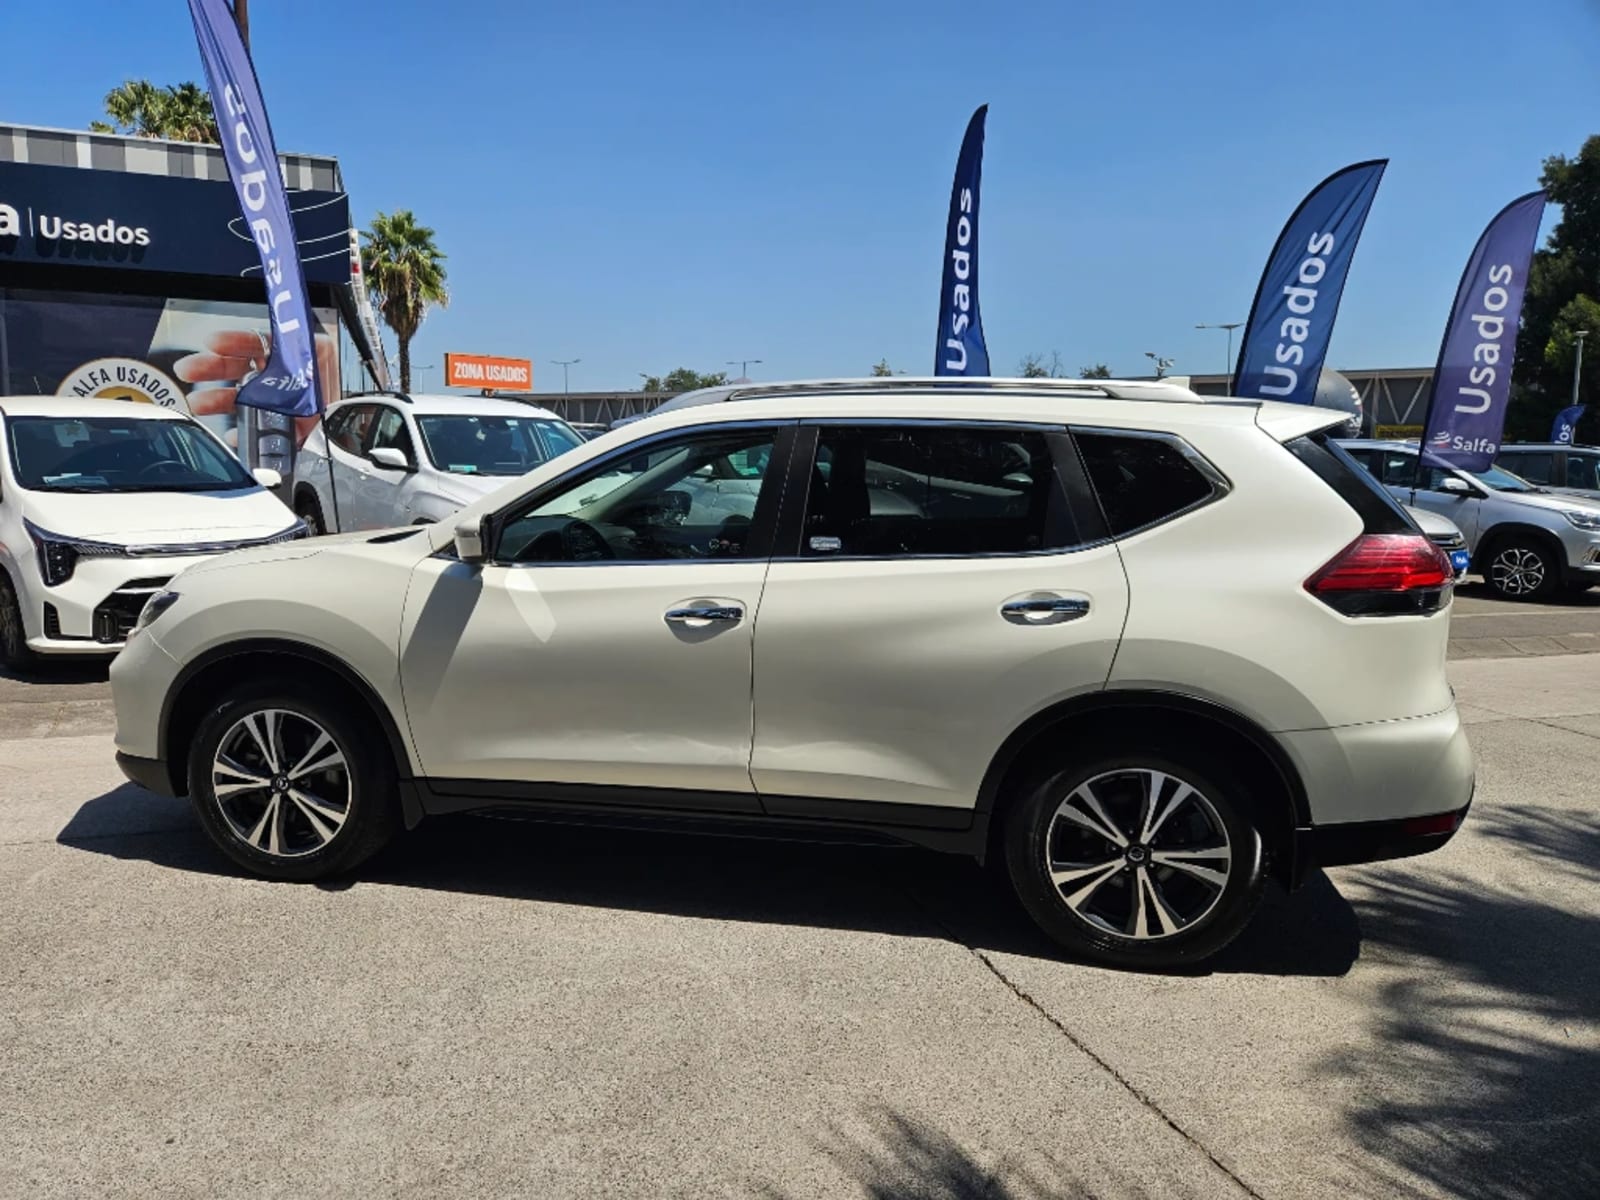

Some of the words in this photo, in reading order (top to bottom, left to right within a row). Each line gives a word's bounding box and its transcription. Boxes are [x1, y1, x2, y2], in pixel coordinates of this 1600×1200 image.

[39, 214, 150, 246] Usados
[945, 187, 972, 371] Usados
[1258, 231, 1335, 397] Usados
[1454, 264, 1513, 415] Usados
[69, 368, 111, 397] ALFA
[116, 366, 176, 407] USADOS
[454, 362, 485, 380] ZONA
[486, 364, 528, 383] USADOS
[1452, 435, 1496, 454] Salfa
